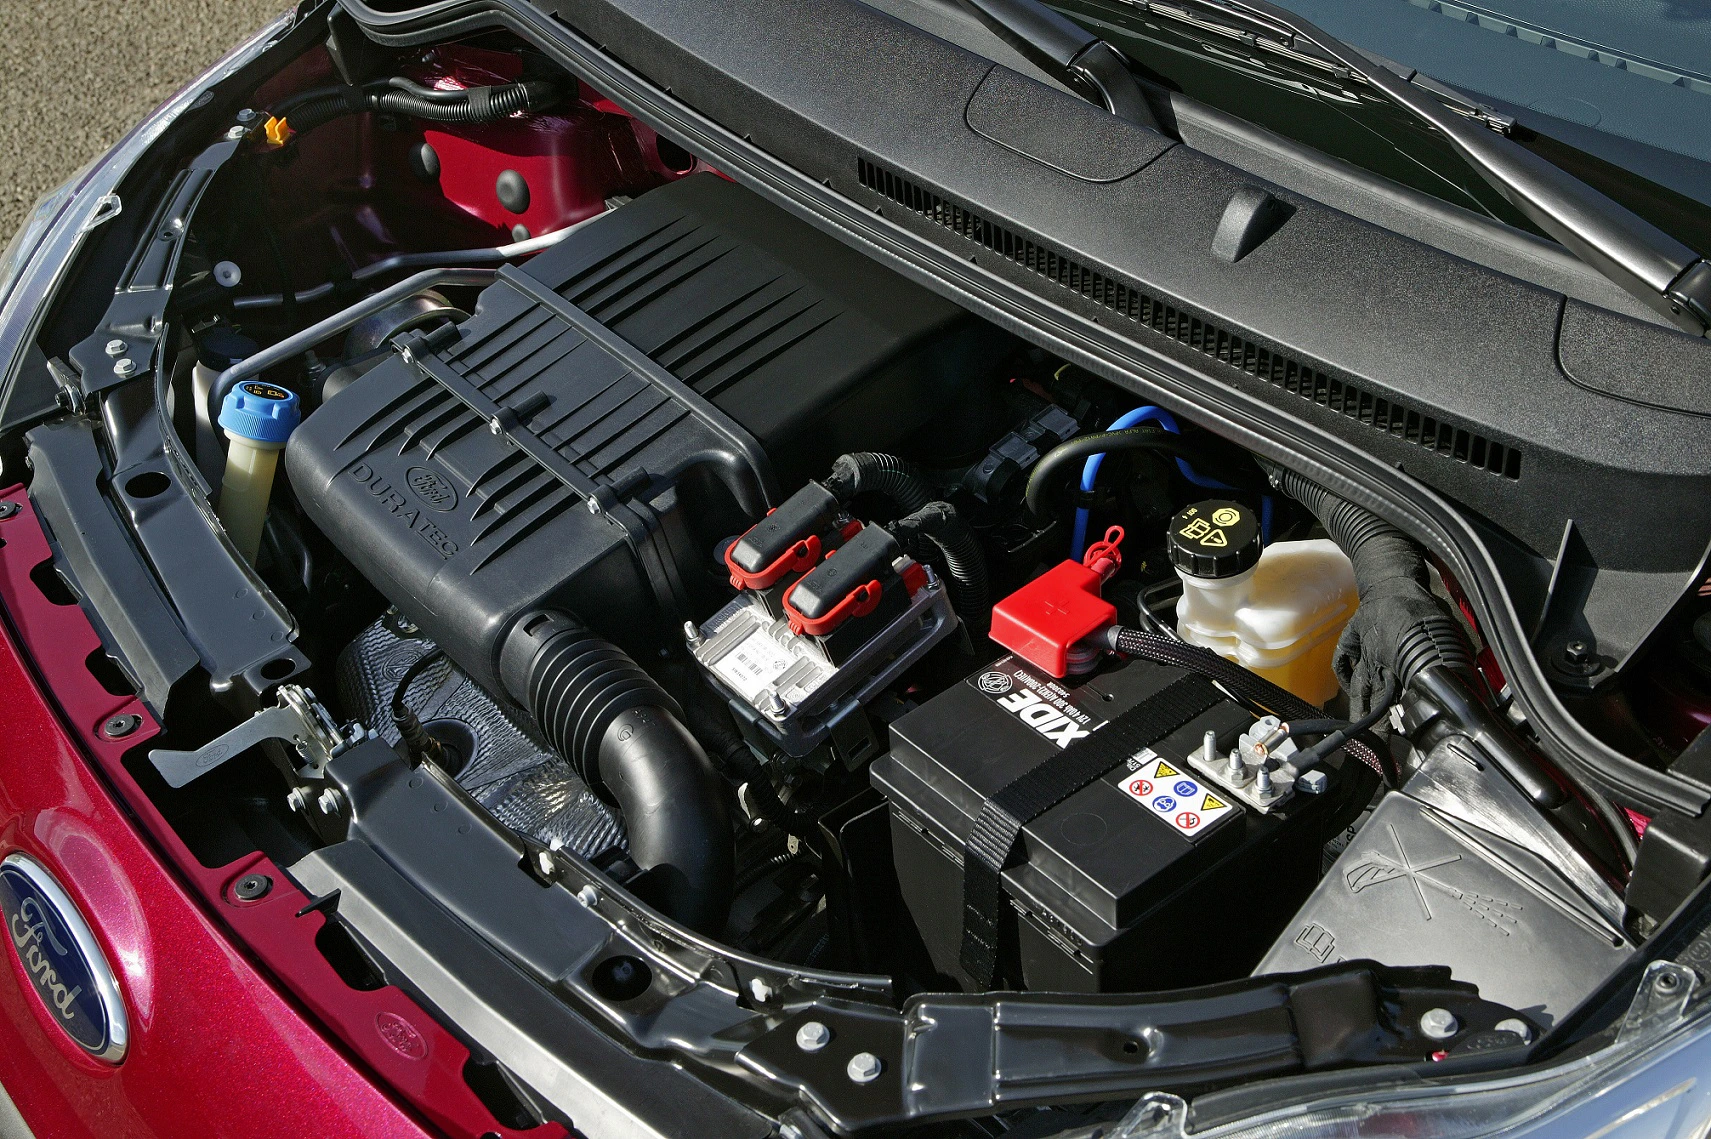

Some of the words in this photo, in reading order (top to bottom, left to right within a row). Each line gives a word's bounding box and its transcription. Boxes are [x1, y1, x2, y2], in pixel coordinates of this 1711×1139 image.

[347, 462, 459, 558] DURATEC
[413, 474, 451, 503] Ford
[12, 896, 83, 1020] Ford
